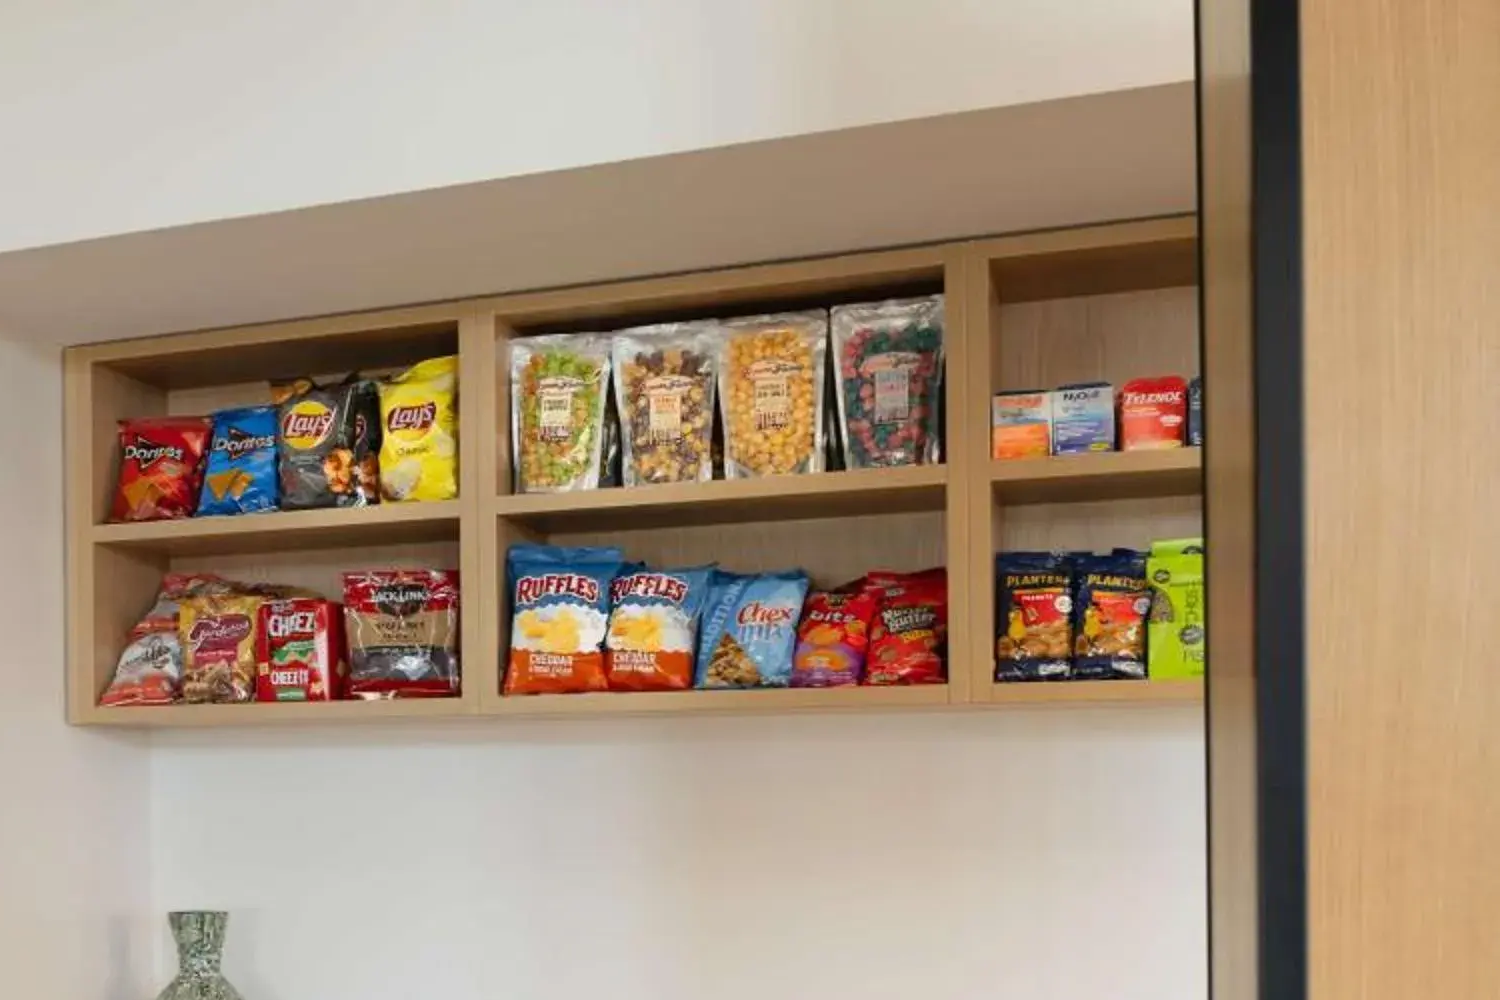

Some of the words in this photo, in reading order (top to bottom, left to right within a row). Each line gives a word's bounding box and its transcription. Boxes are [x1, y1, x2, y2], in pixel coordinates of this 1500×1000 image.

[285, 405, 337, 438] Lay's
[389, 403, 436, 431] Lay's
[124, 444, 183, 460] Doritos
[215, 434, 275, 452] Doritos
[516, 573, 598, 604] RUFFLES
[610, 573, 688, 604] RUFFLES
